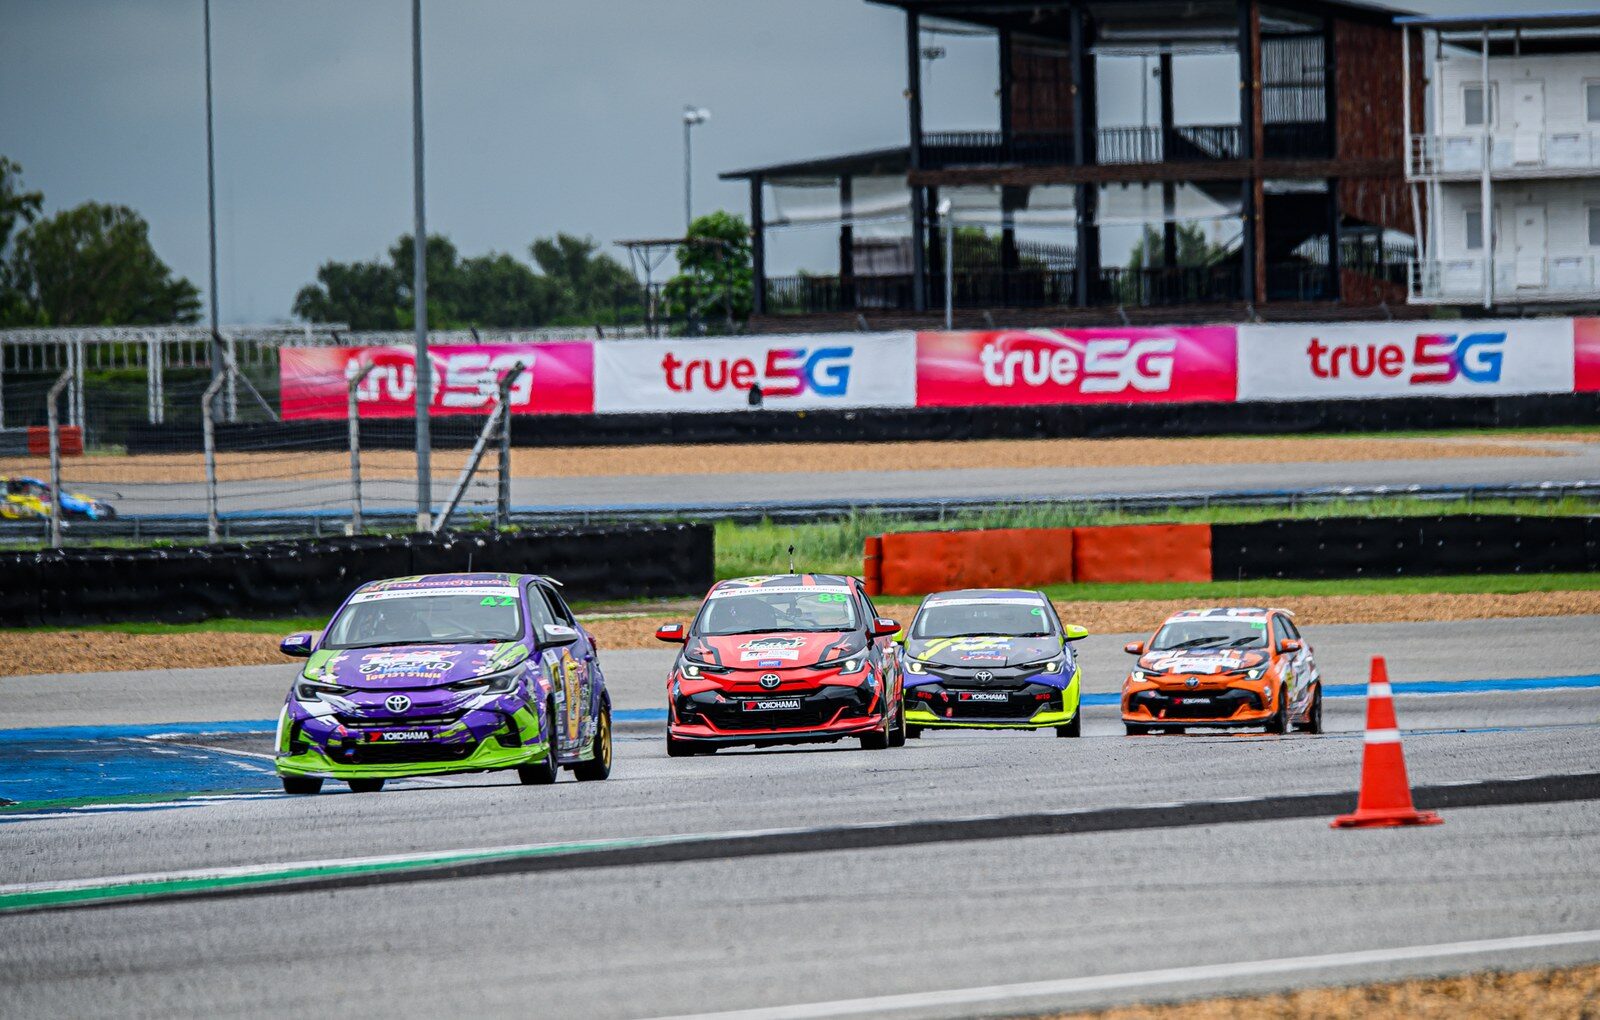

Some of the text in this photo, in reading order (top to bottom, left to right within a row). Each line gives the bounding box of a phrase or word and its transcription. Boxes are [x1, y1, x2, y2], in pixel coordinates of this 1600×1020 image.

[1307, 332, 1507, 385] true 5G
[661, 346, 853, 397] true 5G
[980, 338, 1177, 393] true 5G
[442, 353, 536, 407] 5G
[480, 595, 515, 607] 42
[818, 592, 847, 604] 88
[971, 693, 1007, 701] YOKOHAMA
[757, 701, 799, 709] YOKOHAMA
[383, 731, 429, 740] YOKOHAMA
